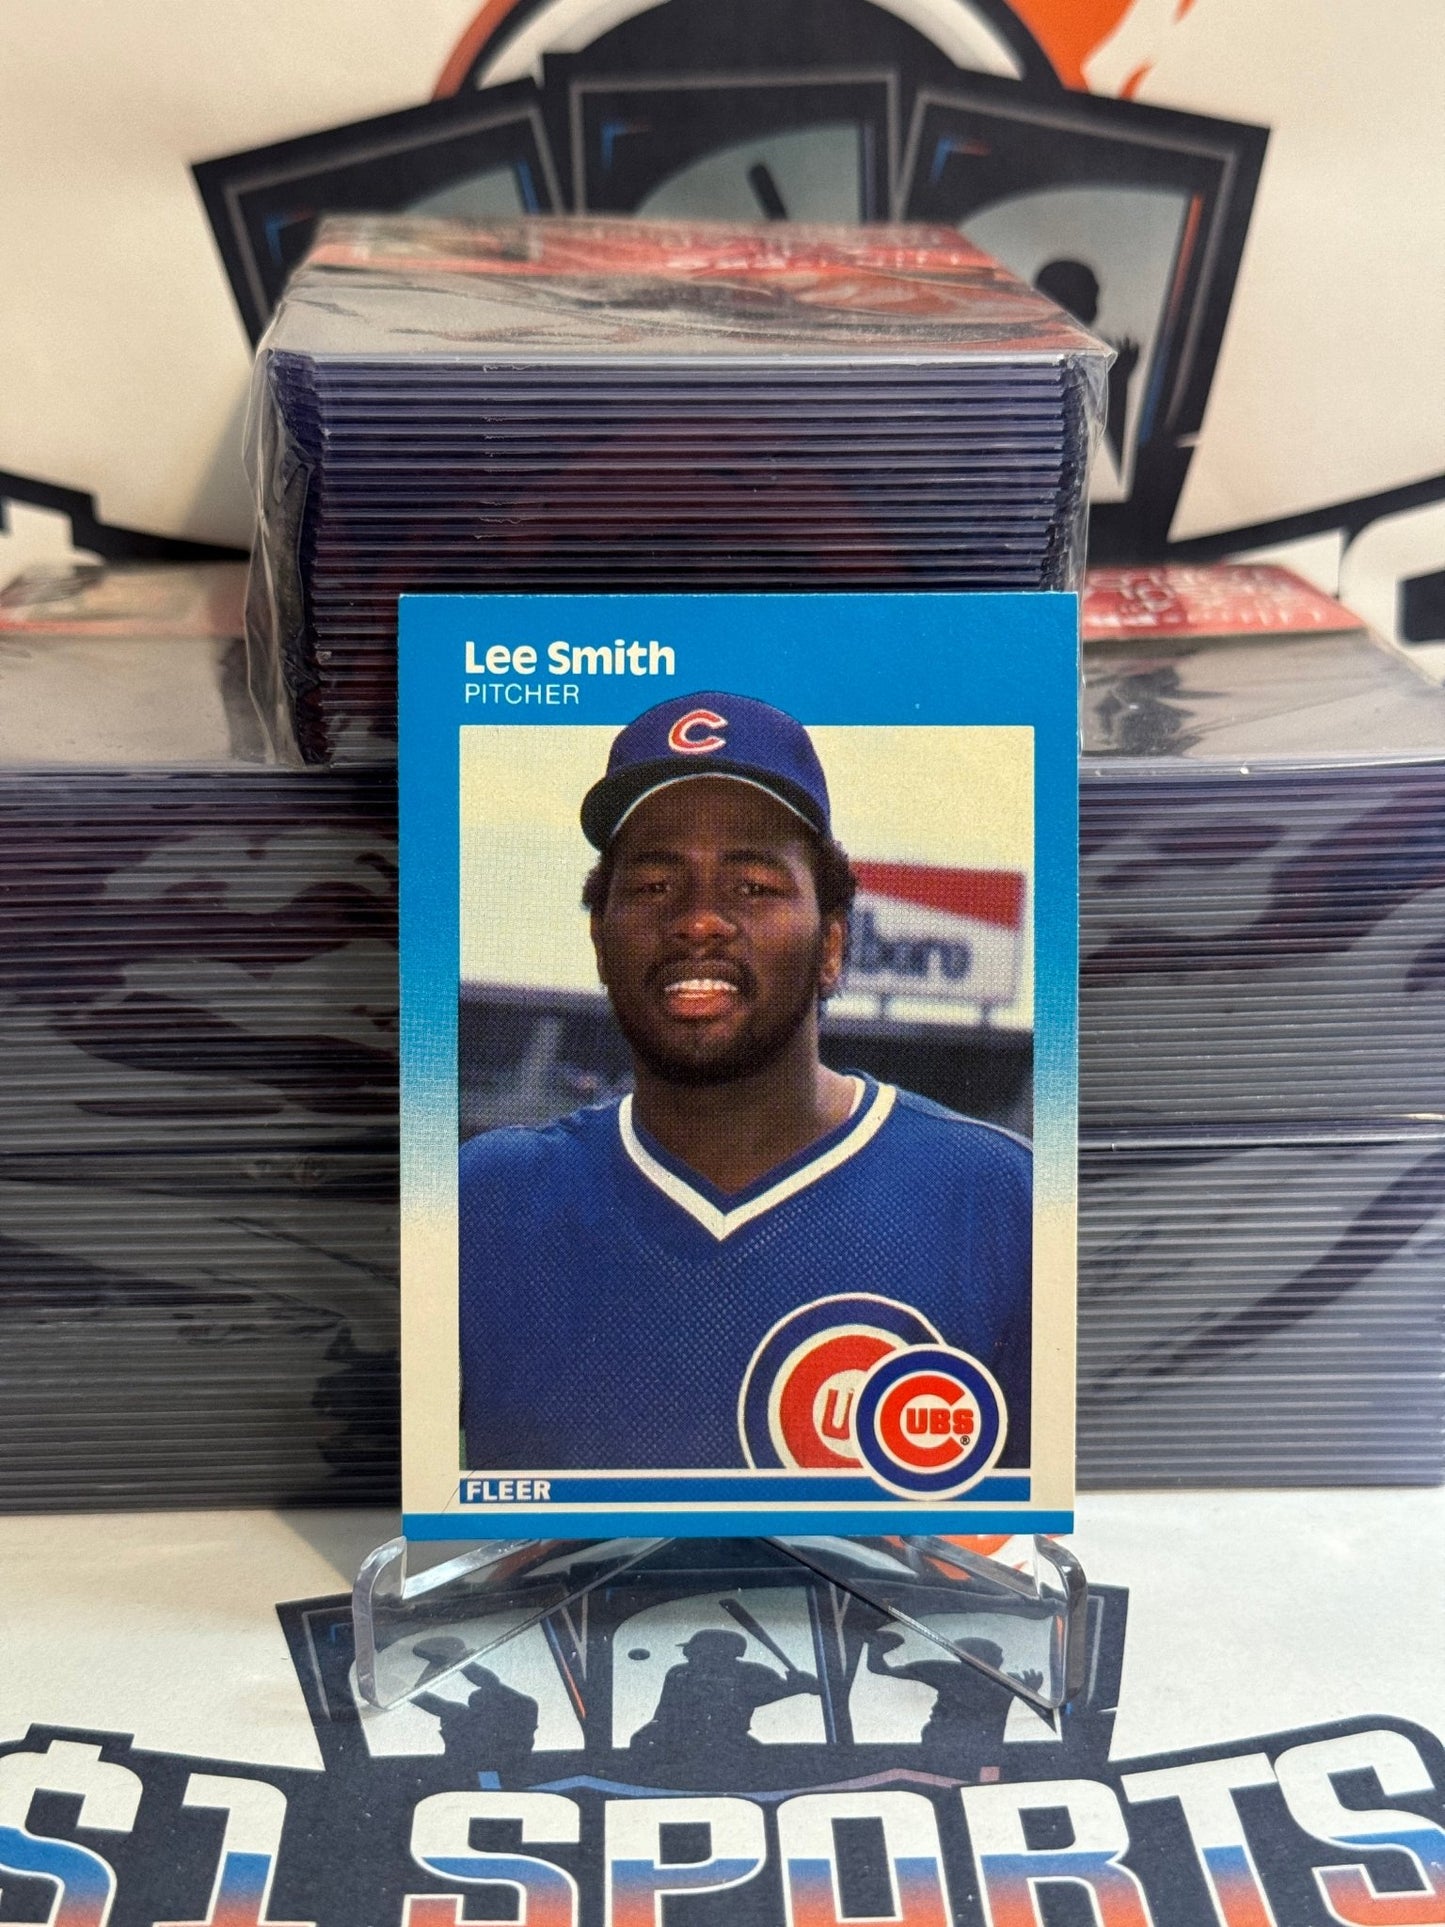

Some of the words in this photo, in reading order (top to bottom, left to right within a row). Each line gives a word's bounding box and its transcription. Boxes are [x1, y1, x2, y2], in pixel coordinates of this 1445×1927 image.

[465, 640, 538, 675] Lee
[548, 638, 676, 676] Smith
[464, 682, 580, 704] PITCHER
[667, 708, 729, 755] C
[879, 1374, 975, 1468] CUBS
[466, 1480, 551, 1501] FLEER
[402, 1730, 1445, 1927] SPORTS
